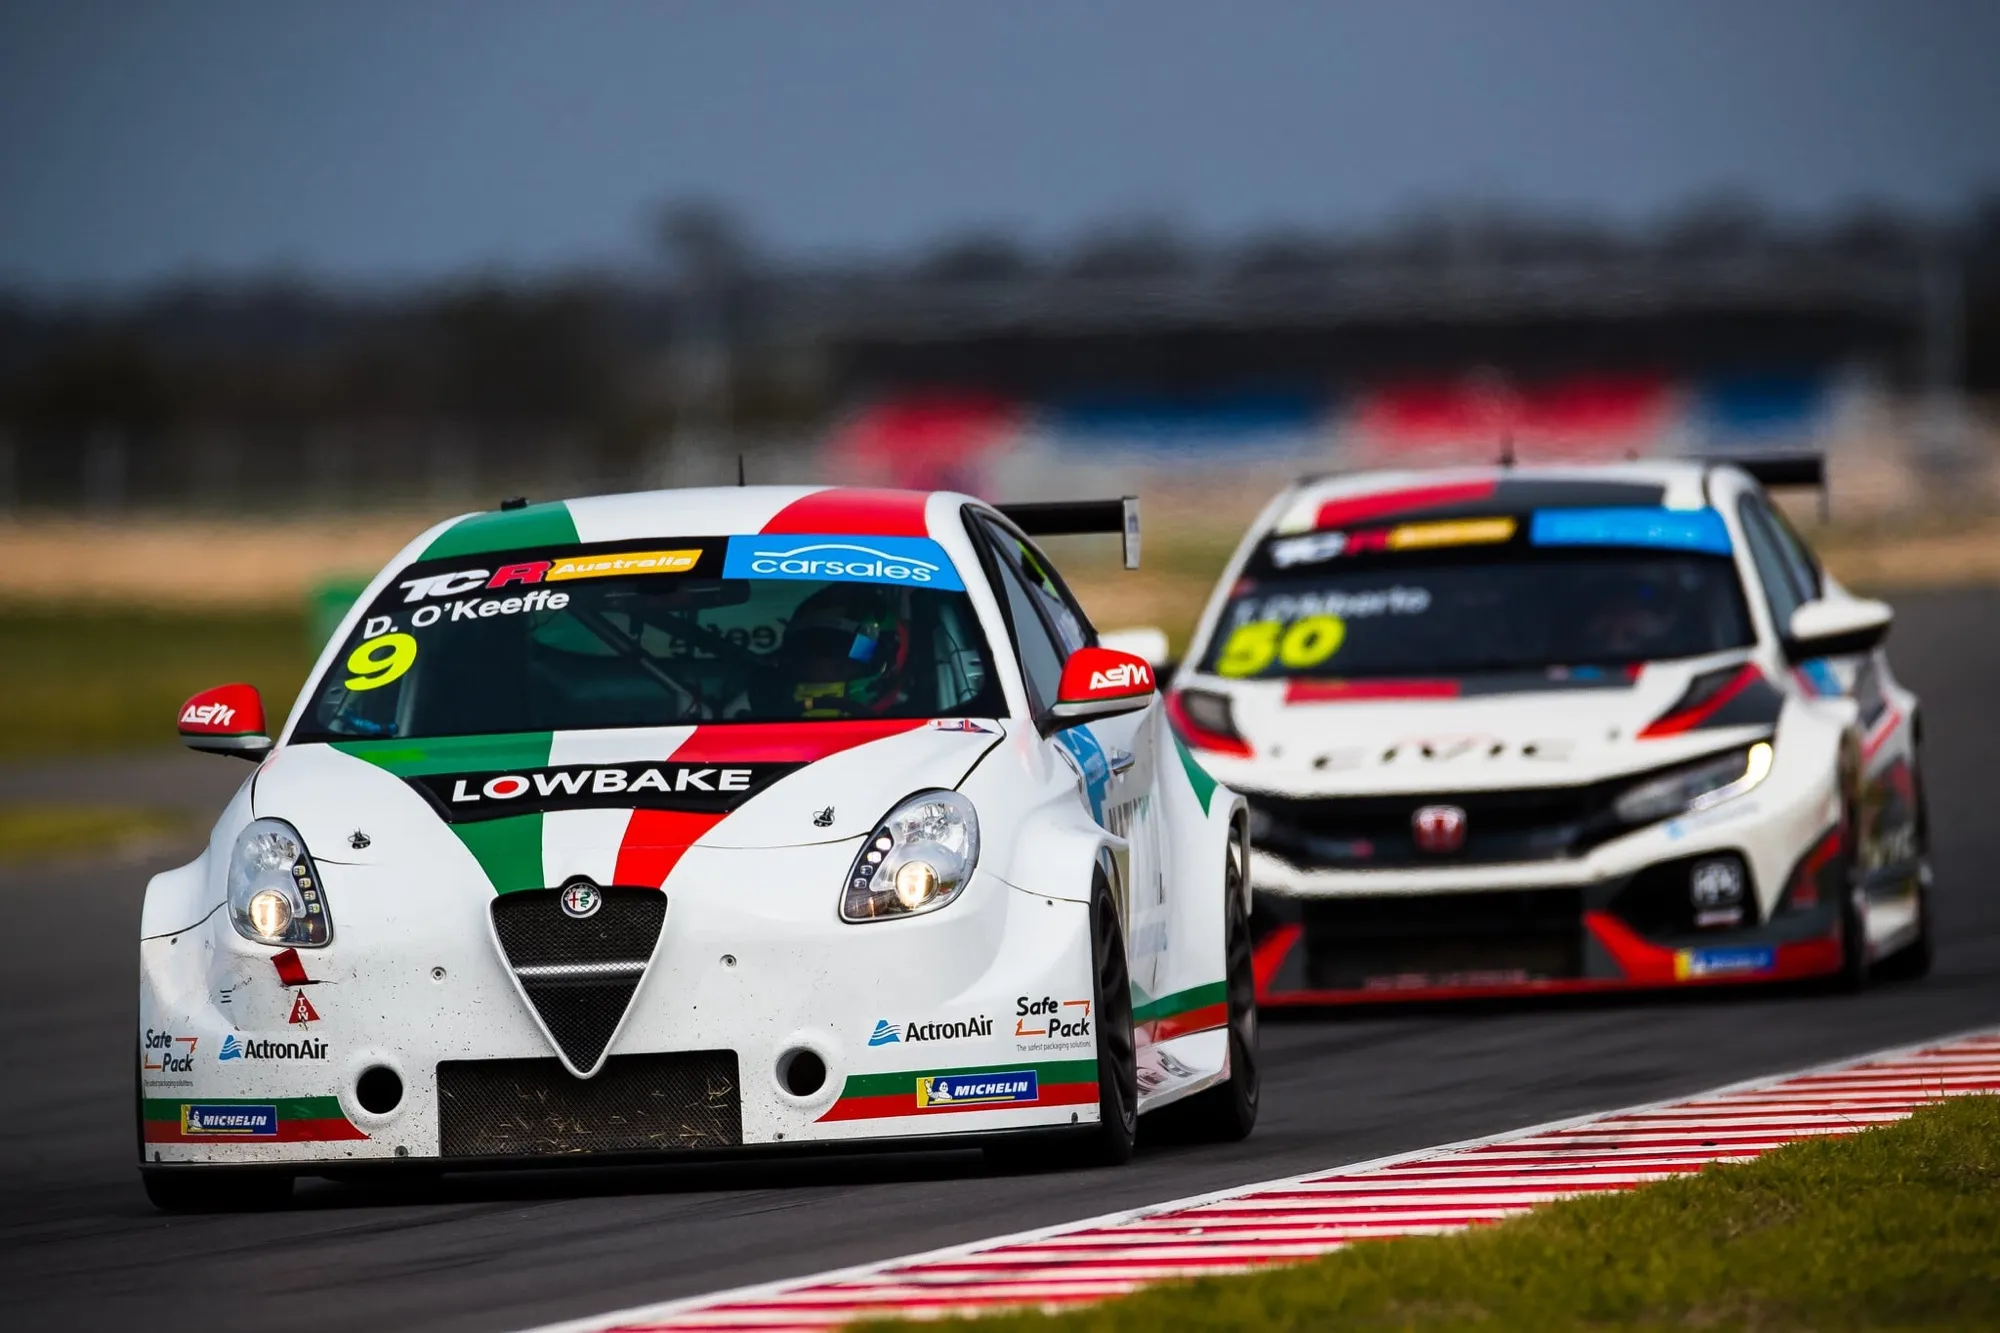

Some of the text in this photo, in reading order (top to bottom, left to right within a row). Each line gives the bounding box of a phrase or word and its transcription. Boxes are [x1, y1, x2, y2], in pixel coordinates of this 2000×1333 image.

[400, 556, 692, 603] TCR Australia
[751, 559, 932, 582] carsales
[363, 589, 570, 640] D. O'Keeffe
[1215, 614, 1346, 679] 50
[344, 632, 417, 692] 9
[1089, 664, 1150, 690] ASM
[181, 702, 236, 727] ASM
[451, 768, 753, 803] LOWBAKE
[1016, 996, 1058, 1017] Safe
[145, 1028, 172, 1050] Safe
[905, 1014, 994, 1043] ActronAir
[1048, 1017, 1091, 1038] Pack
[244, 1038, 329, 1060] ActronAir
[1044, 1042, 1069, 1052] packaging
[162, 1052, 194, 1073] Pack
[953, 1081, 1029, 1097] MICHELIN
[203, 1114, 268, 1127] MICHELIN
